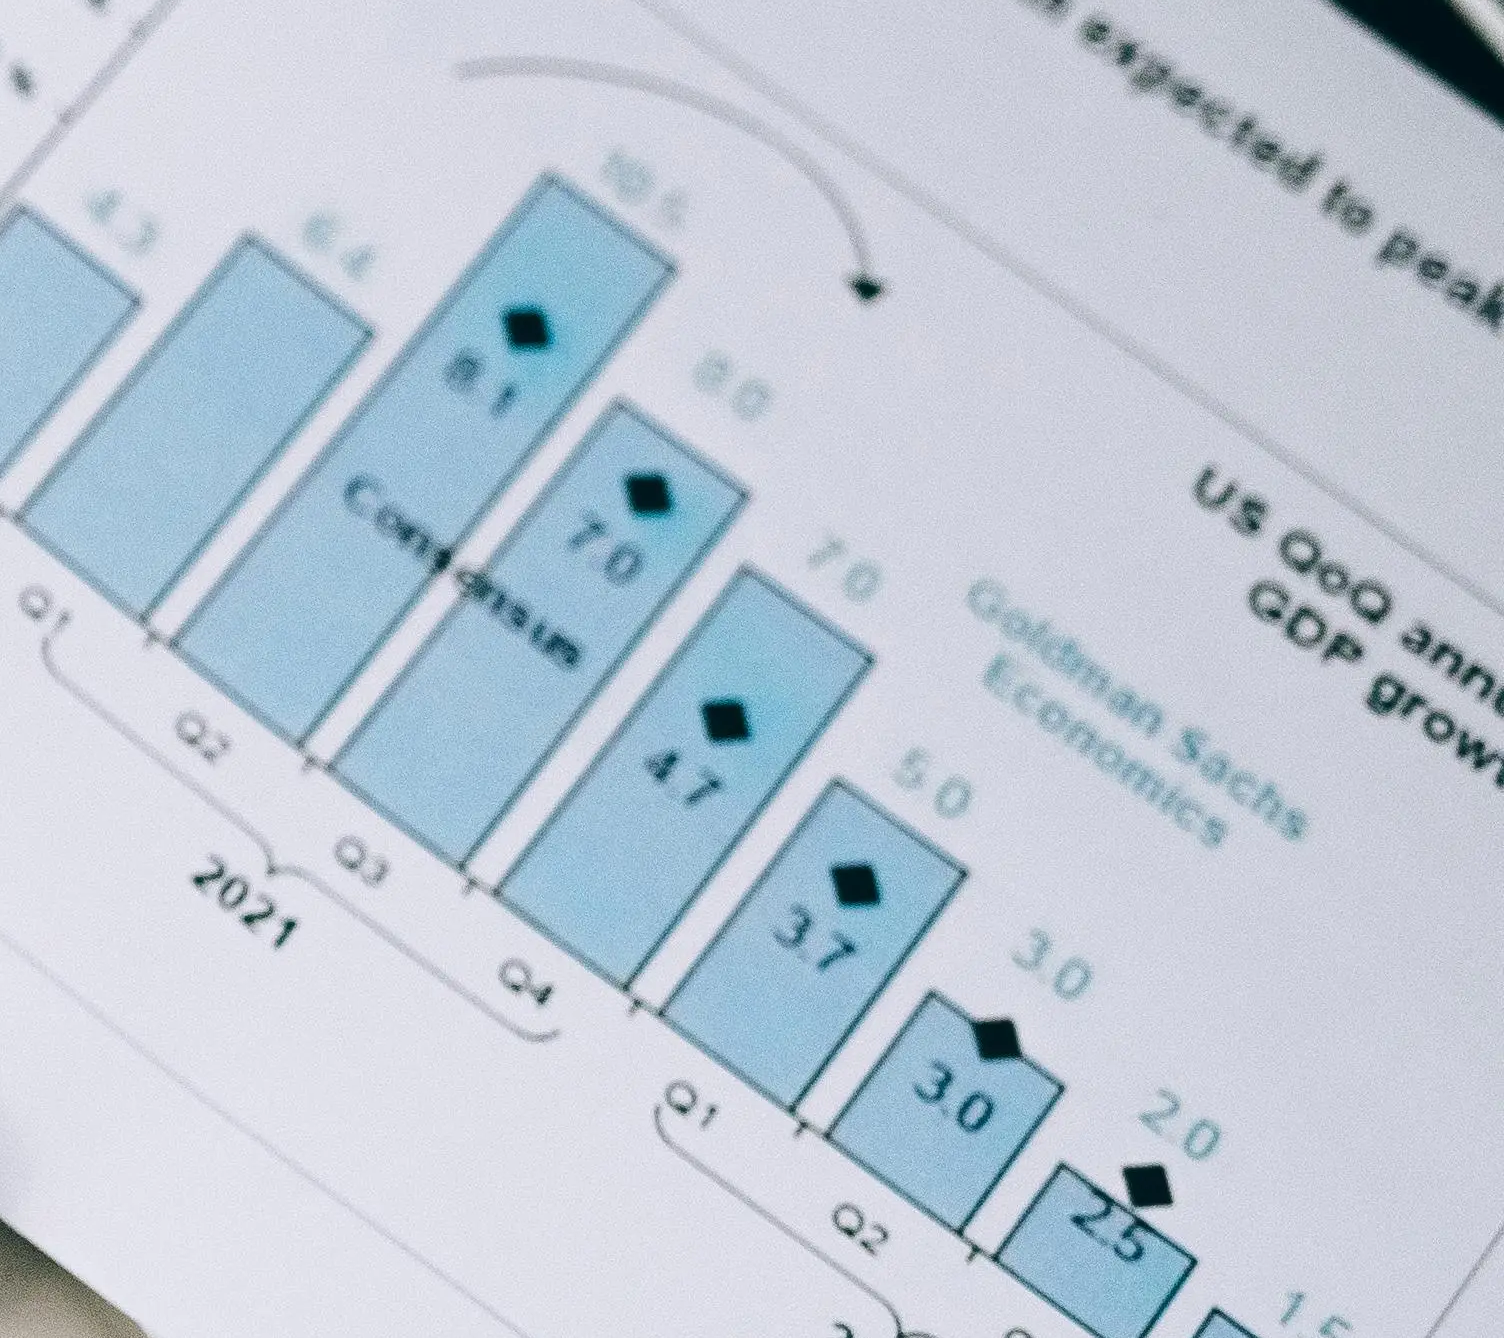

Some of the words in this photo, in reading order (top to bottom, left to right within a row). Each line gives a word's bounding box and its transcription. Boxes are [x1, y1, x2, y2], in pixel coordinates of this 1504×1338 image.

[1078, 19, 1325, 194] expected
[1322, 180, 1374, 234] to
[1377, 227, 1504, 330] peak
[1192, 463, 1270, 537] US
[1278, 529, 1395, 624] QoQ
[17, 583, 74, 635] Q1
[1248, 580, 1365, 666] GDP
[173, 709, 233, 763] Q2
[966, 577, 1164, 739] Goldman
[1169, 723, 1309, 842] Sachs
[646, 745, 721, 807] 4.7
[982, 653, 1230, 850] Economics
[333, 834, 390, 888] Q3
[191, 852, 299, 950] 2021
[771, 904, 857, 975] 3.7
[1010, 926, 1094, 1005] 3.0
[497, 958, 557, 1008] Q4
[663, 1079, 718, 1130] Q1
[913, 1059, 994, 1135] 3.0
[1137, 1089, 1224, 1163] 2.0
[831, 1202, 890, 1257] Q2
[1070, 1196, 1147, 1266] 2.5
